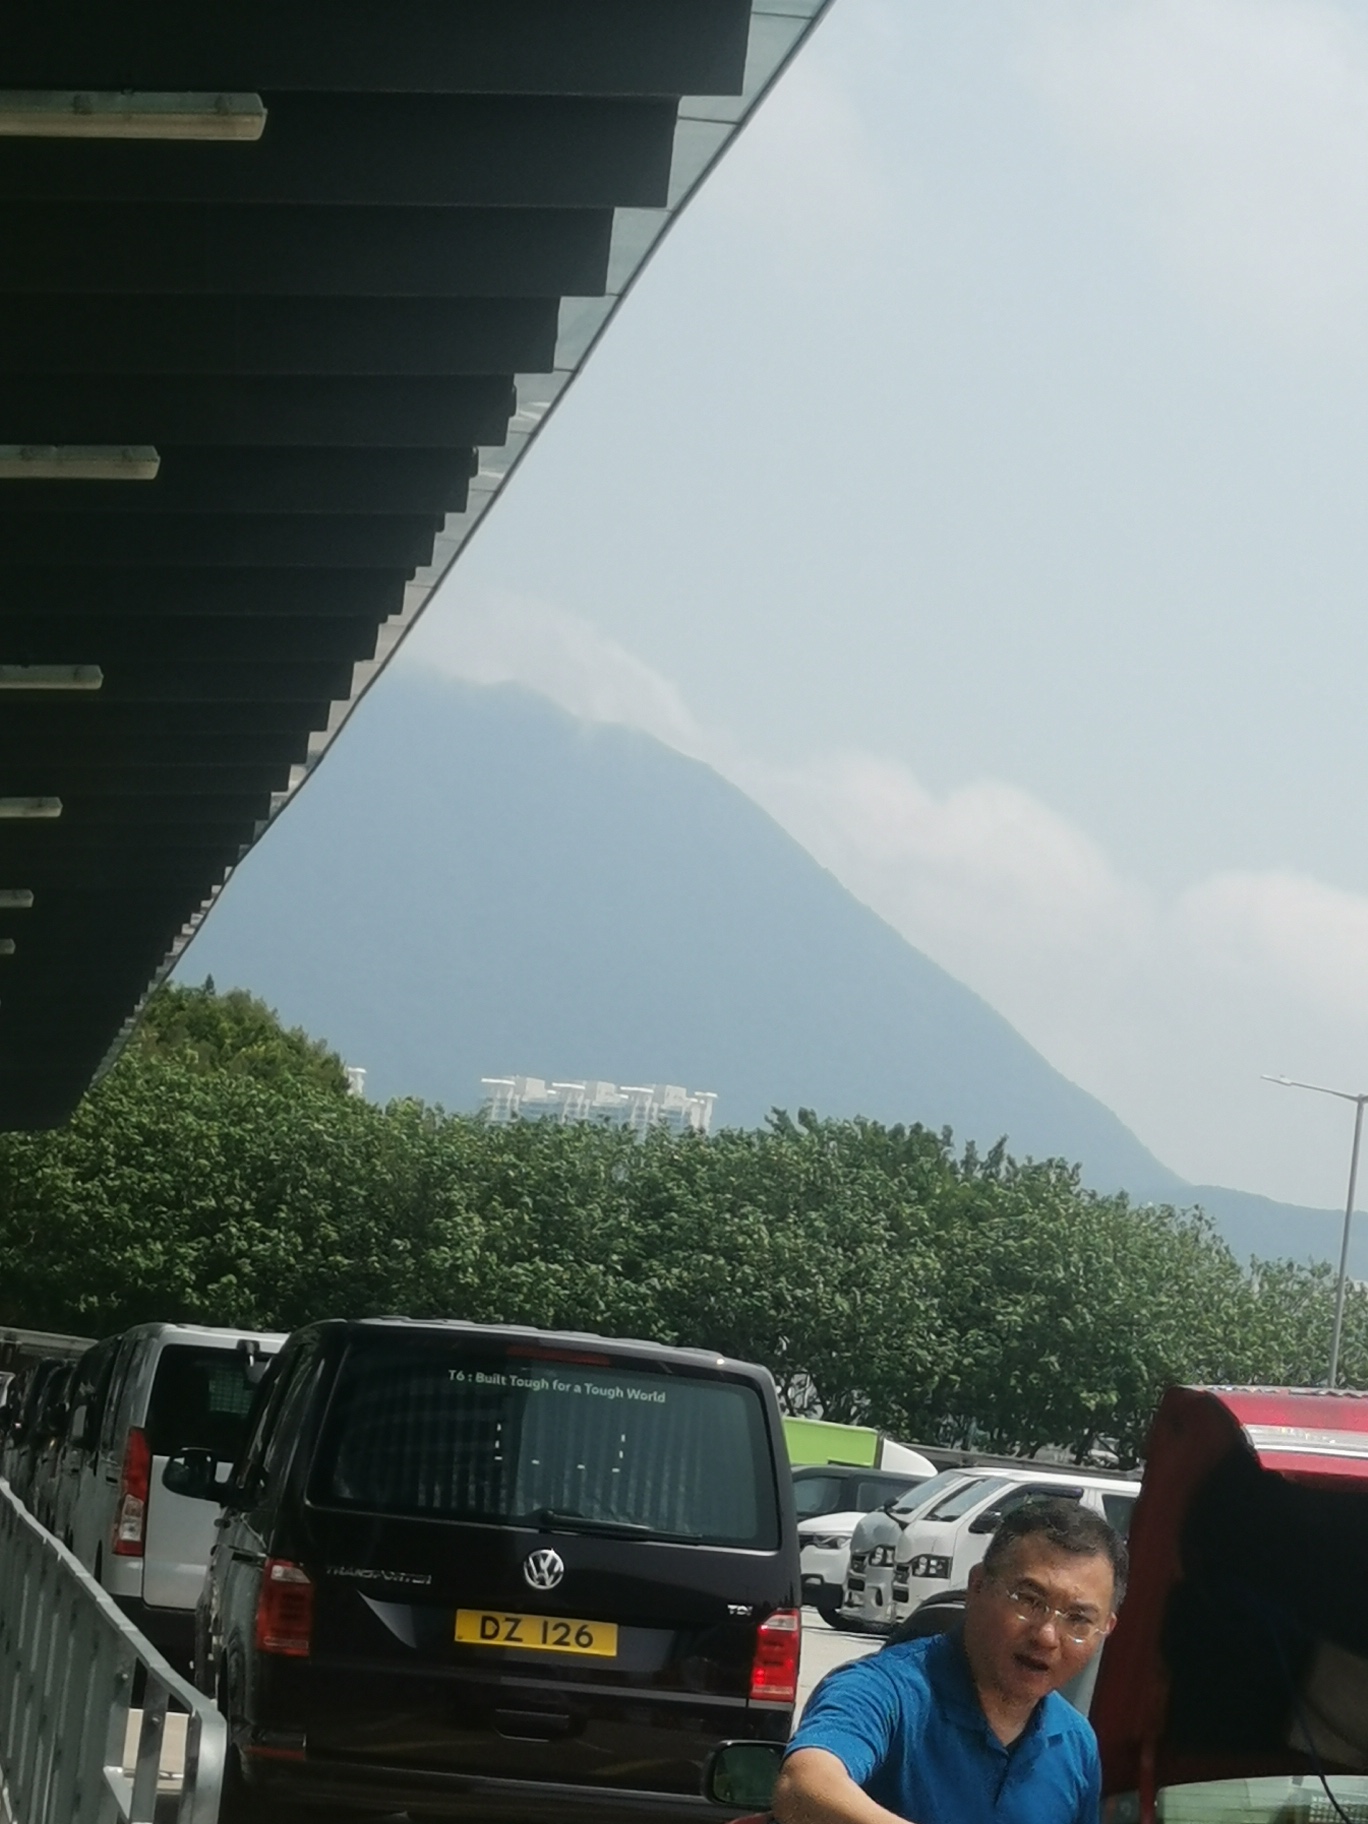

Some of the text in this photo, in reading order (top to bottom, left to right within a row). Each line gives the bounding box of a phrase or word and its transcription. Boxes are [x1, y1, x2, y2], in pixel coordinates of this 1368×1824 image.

[448, 1369, 465, 1382] T6
[475, 1372, 506, 1386] Built
[509, 1375, 549, 1391] Tough
[552, 1379, 571, 1393] for
[573, 1384, 582, 1394] a
[584, 1383, 624, 1399] Tough
[627, 1388, 666, 1403] World
[479, 1615, 594, 1649] DZ 126
